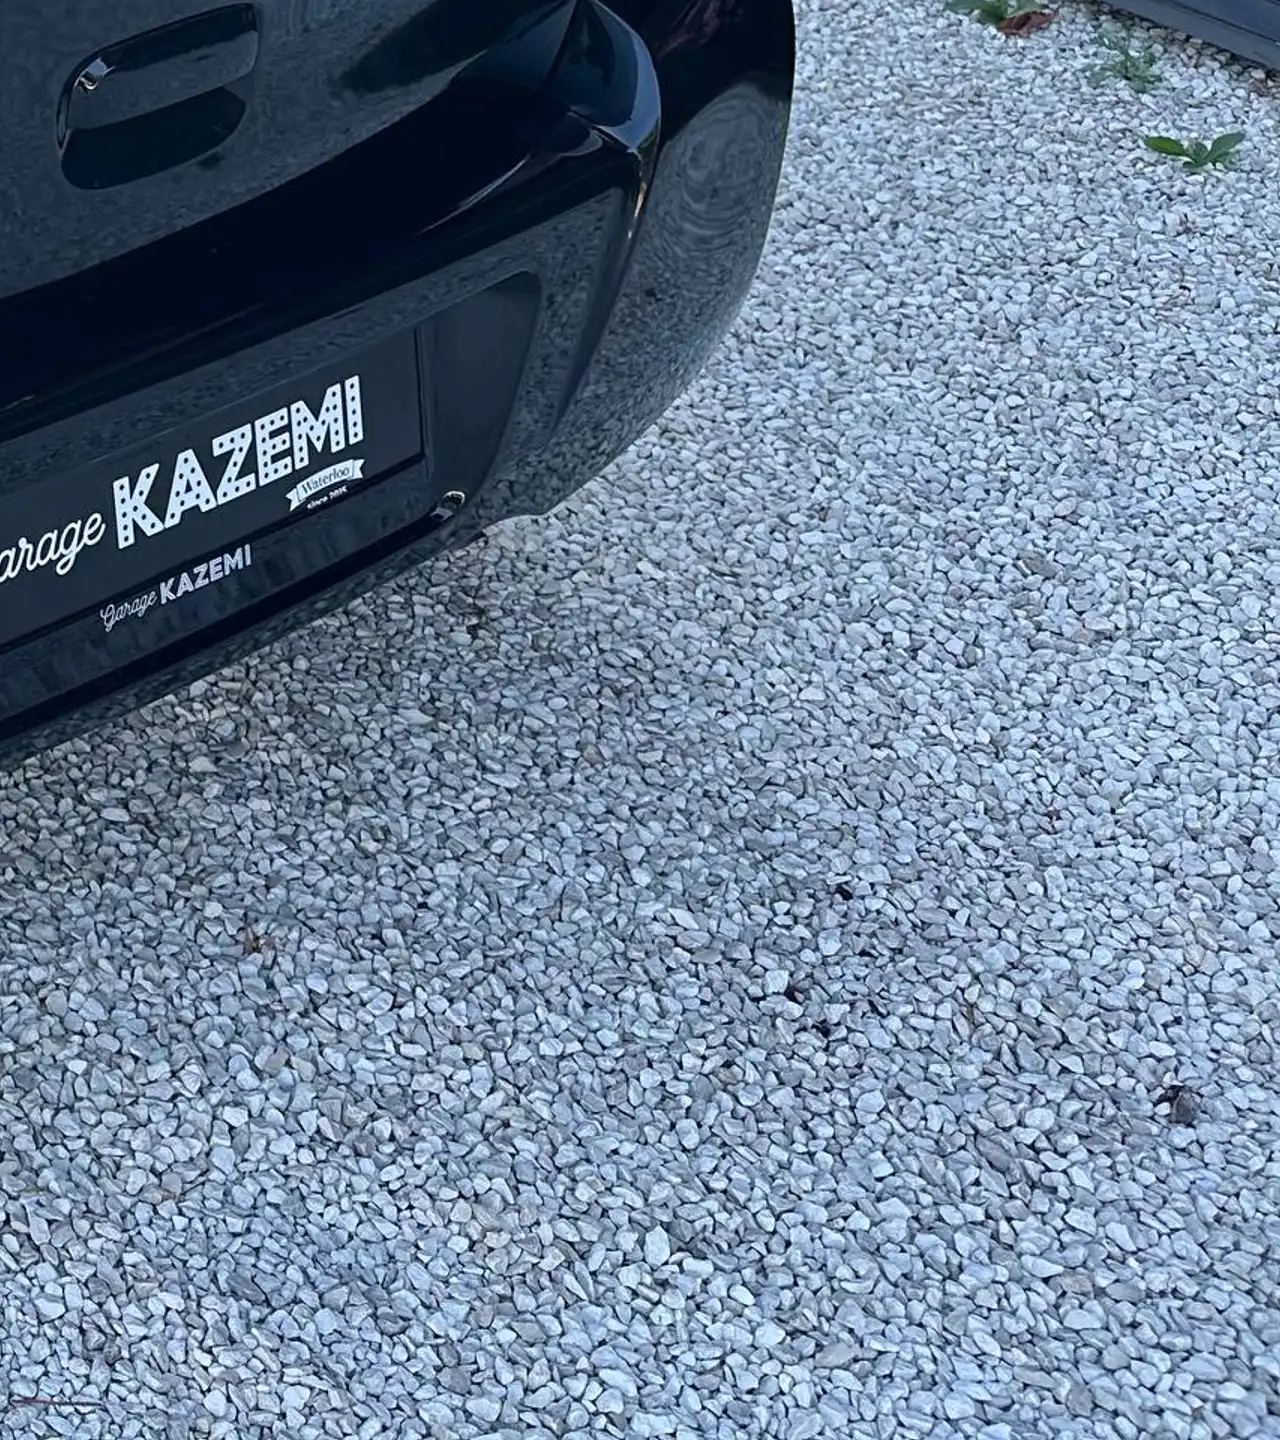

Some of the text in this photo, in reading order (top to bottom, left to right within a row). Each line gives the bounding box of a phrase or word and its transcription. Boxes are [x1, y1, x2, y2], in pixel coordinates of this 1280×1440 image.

[111, 375, 365, 550] KAZEMI
[301, 466, 350, 494] Waterloo
[99, 543, 253, 633] Garage KAZEMI
